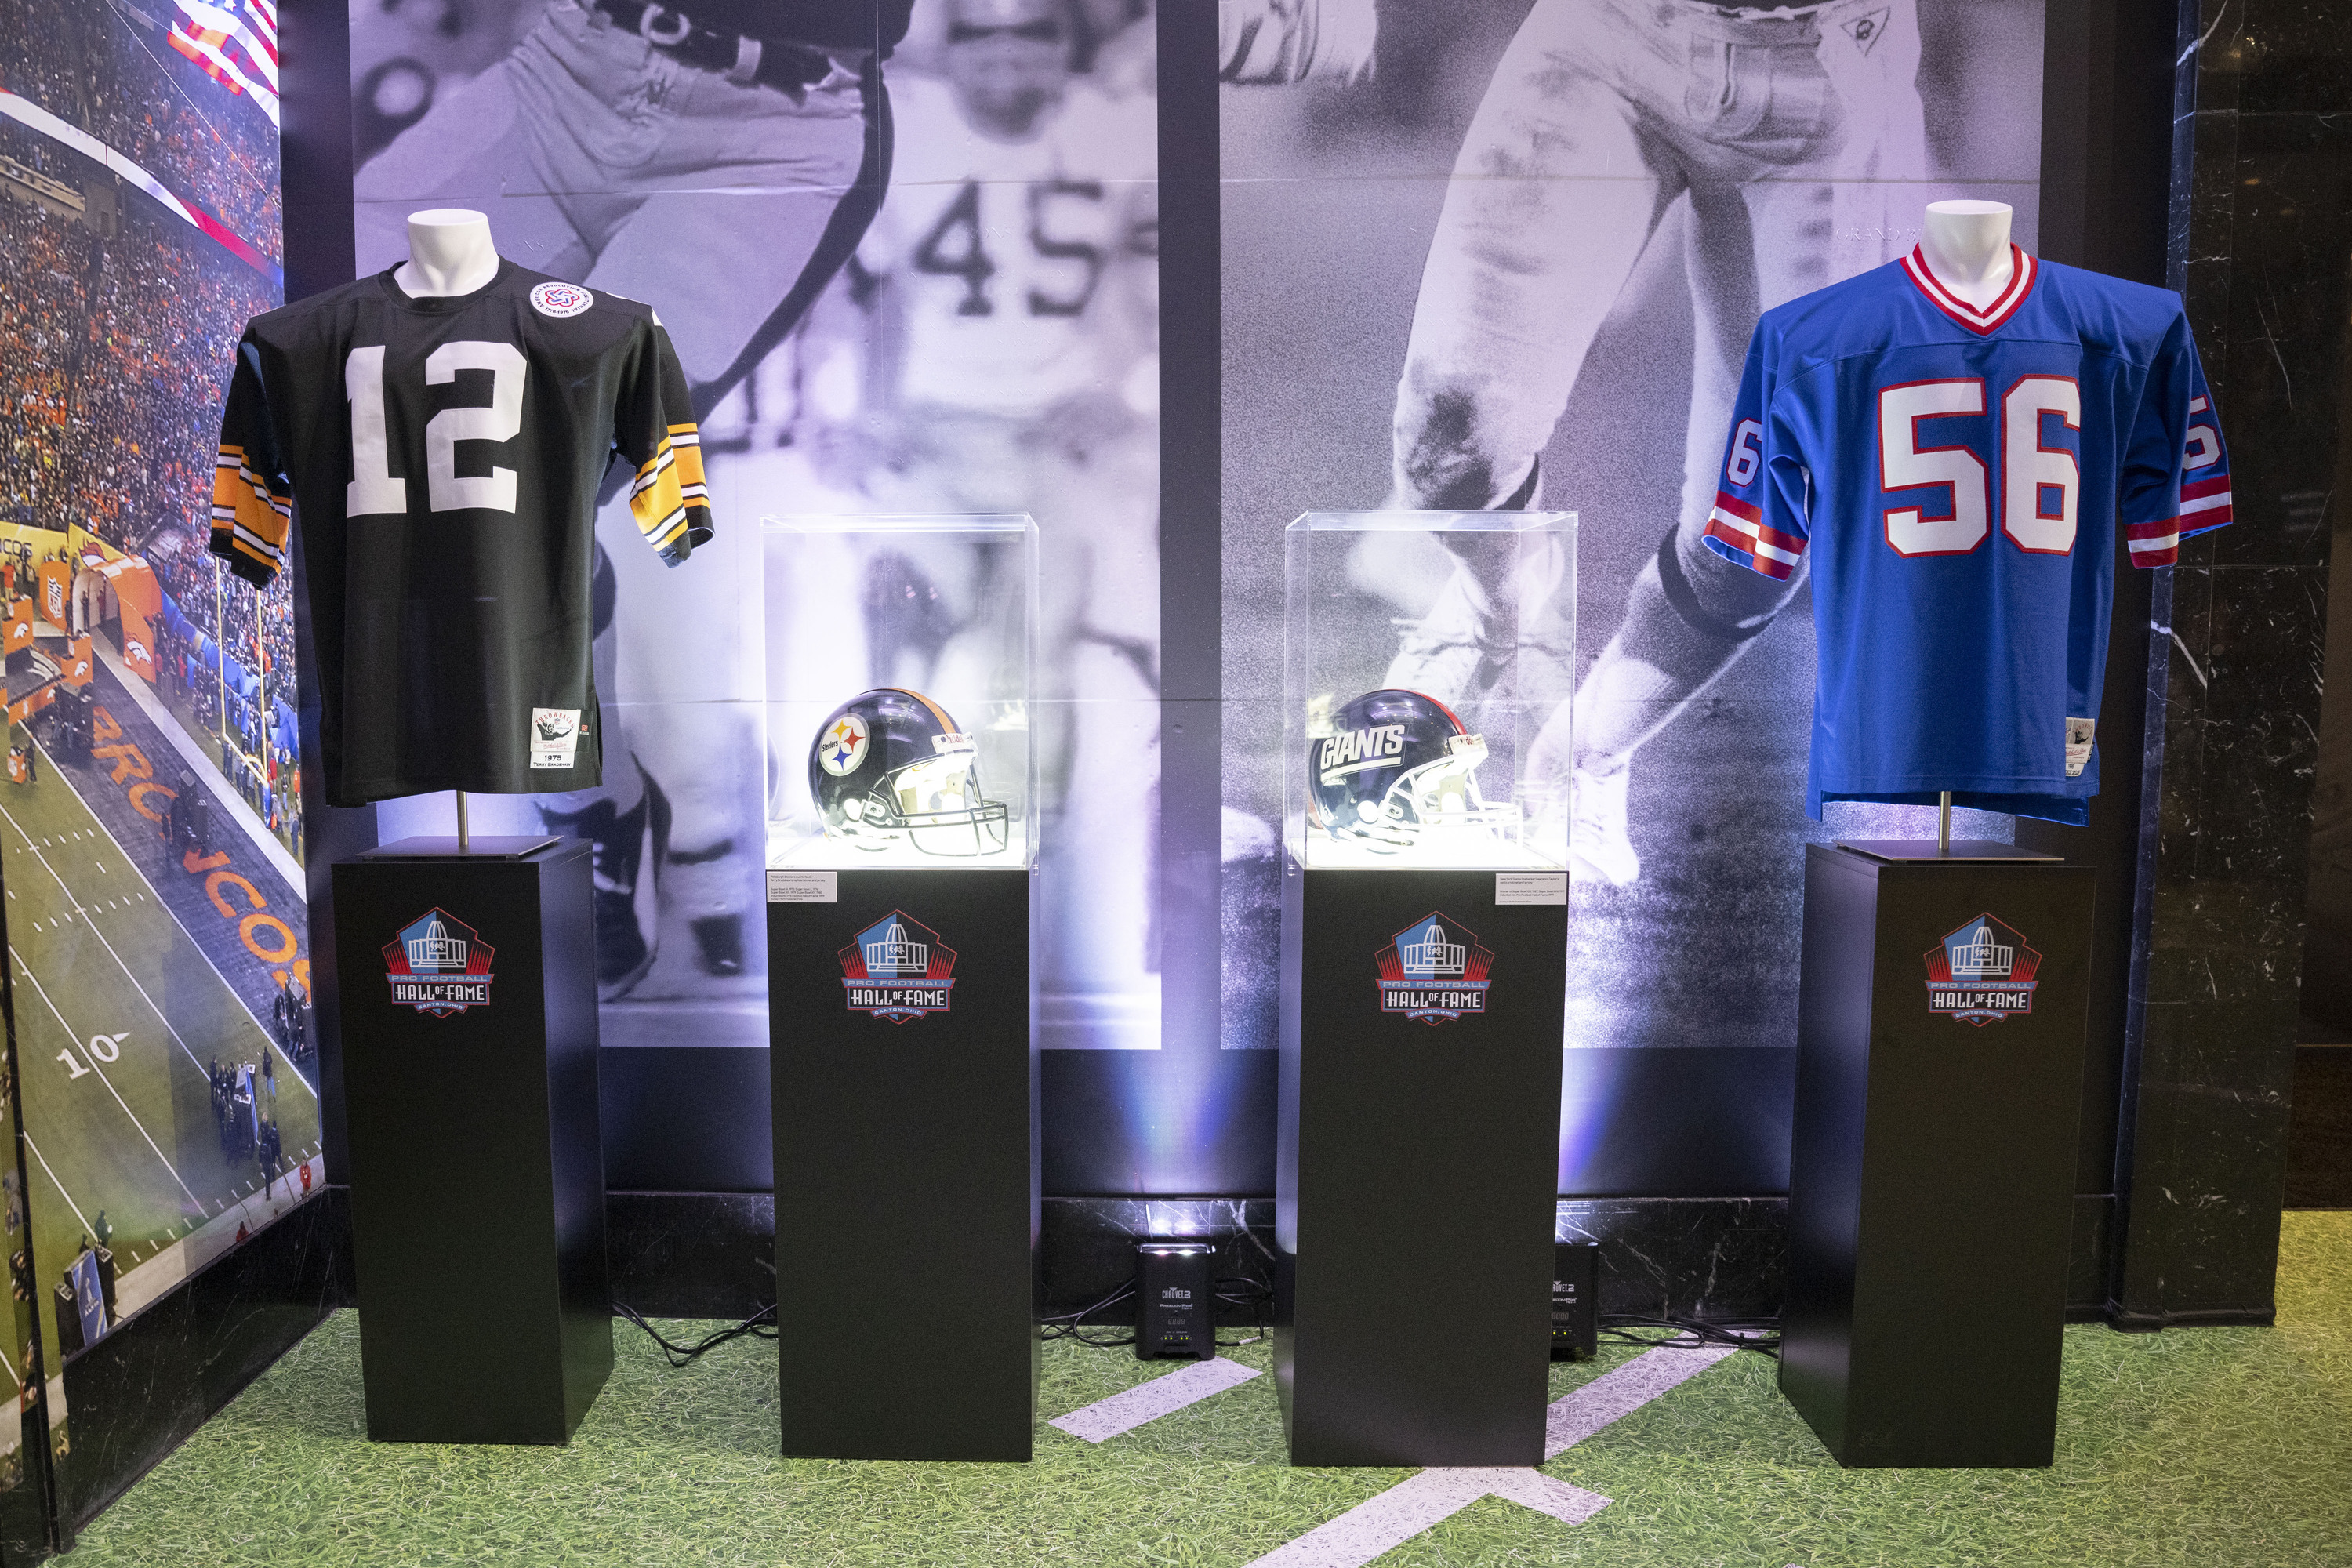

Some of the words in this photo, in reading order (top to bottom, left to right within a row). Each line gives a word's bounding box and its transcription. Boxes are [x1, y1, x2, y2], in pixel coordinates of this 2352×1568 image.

[912, 180, 1102, 318] 45
[345, 340, 527, 518] 12
[1726, 419, 1762, 488] 6
[1878, 374, 2080, 558] 56
[535, 712, 575, 728] THROWBACKS
[822, 740, 839, 753] Steelers
[1320, 724, 1406, 771] GIANTS
[395, 985, 435, 1000] HALL
[435, 985, 445, 995] OF
[445, 985, 485, 1000] FAME
[851, 989, 892, 1005] HALL
[892, 990, 902, 1000] OF
[903, 989, 945, 1006] FAME
[1386, 991, 1428, 1007] HALL
[1428, 993, 1439, 1002] OF
[1439, 992, 1481, 1007] FAME
[1933, 992, 1974, 1008] HALL
[1975, 993, 1985, 1003] OF
[1985, 993, 2027, 1008] FAME
[56, 1034, 120, 1080] 10
